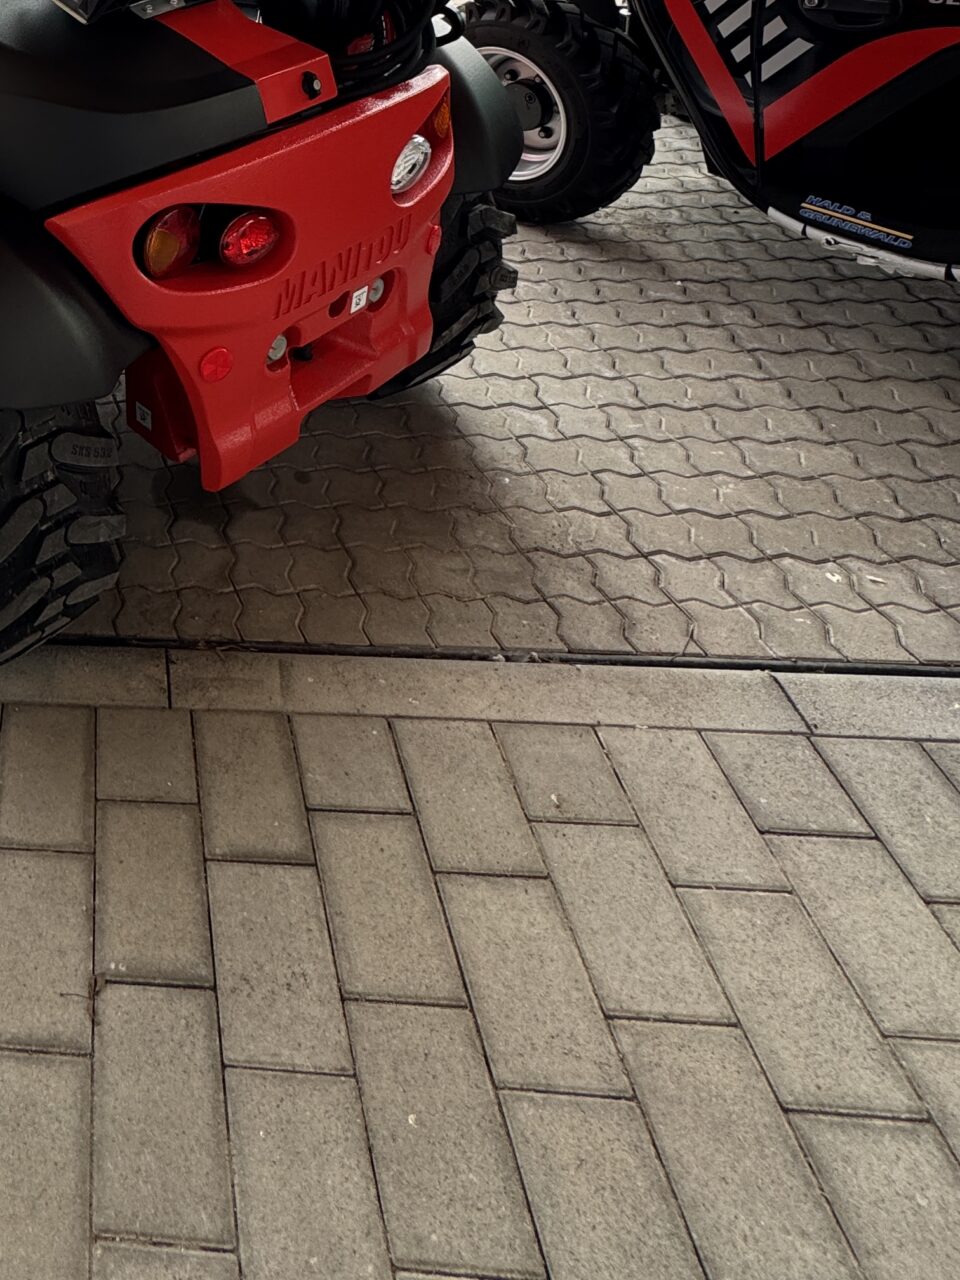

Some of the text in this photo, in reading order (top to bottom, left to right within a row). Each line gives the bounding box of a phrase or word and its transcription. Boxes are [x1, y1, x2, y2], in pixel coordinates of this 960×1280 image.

[805, 194, 872, 221] HALD &
[799, 208, 913, 249] GRUNEWALD
[272, 213, 412, 320] MANITOU
